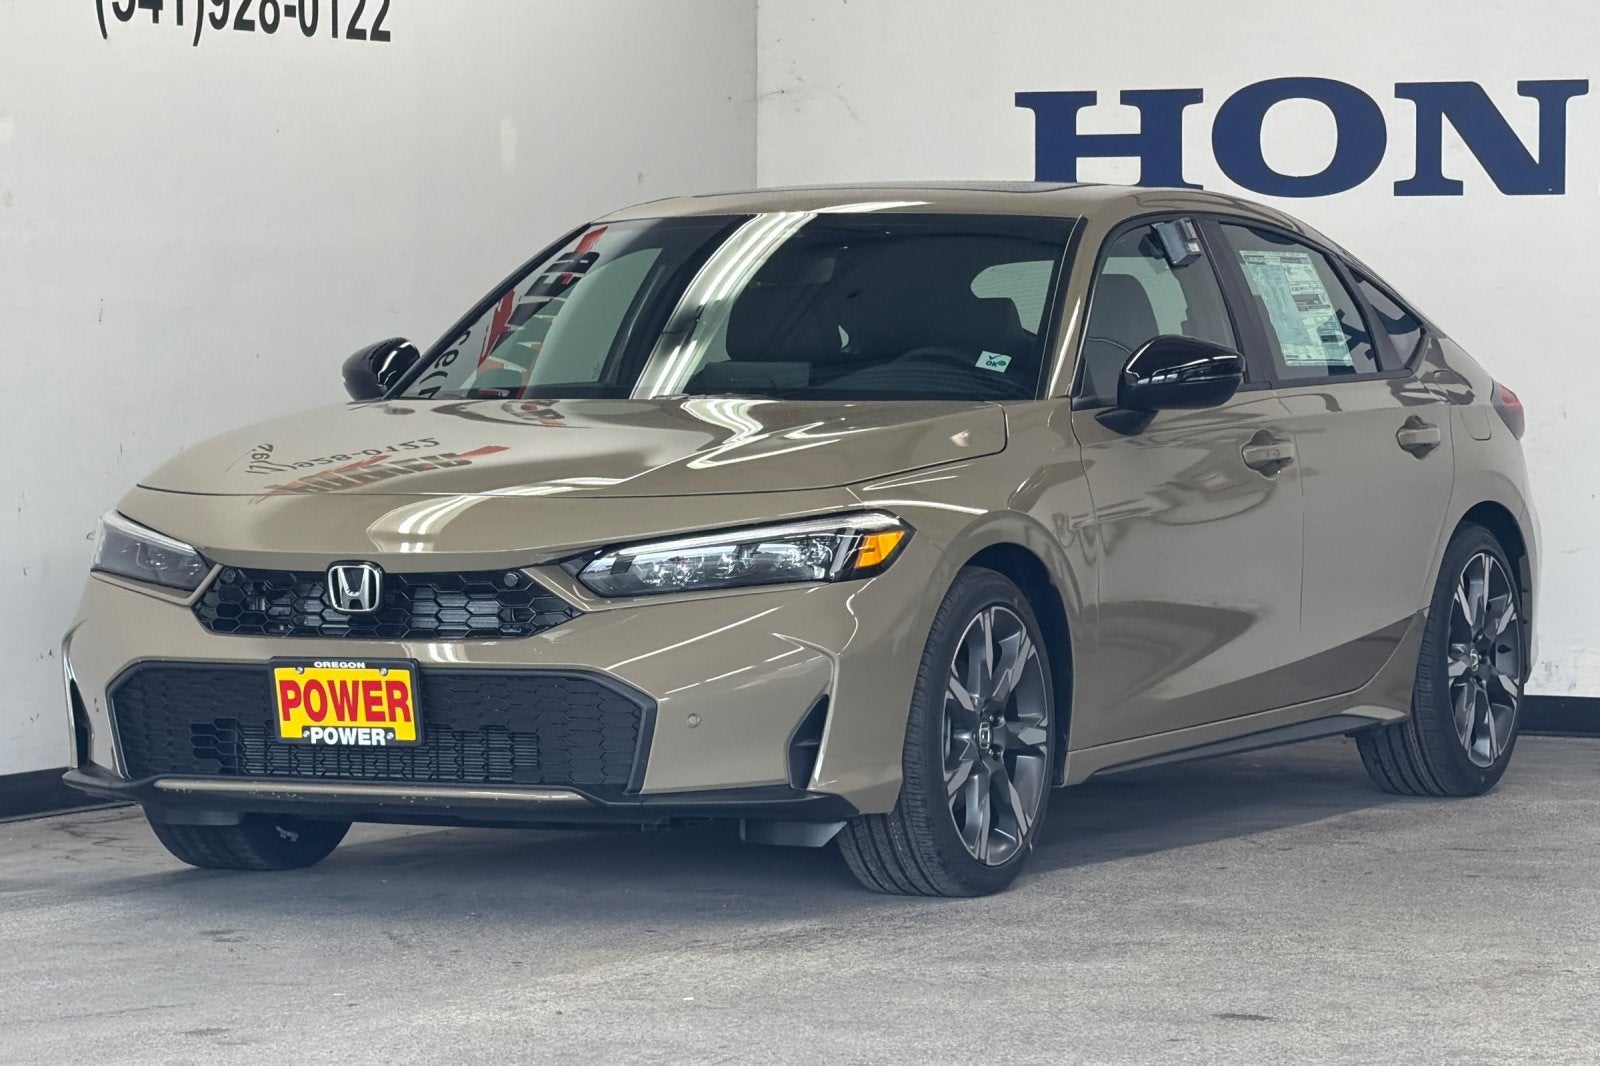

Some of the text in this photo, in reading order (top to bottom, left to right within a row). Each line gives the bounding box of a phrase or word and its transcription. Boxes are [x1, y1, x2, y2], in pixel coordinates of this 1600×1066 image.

[1015, 76, 1589, 198] HON
[313, 661, 366, 669] OREGON
[279, 679, 411, 722] POWER
[310, 727, 386, 746] POWER
